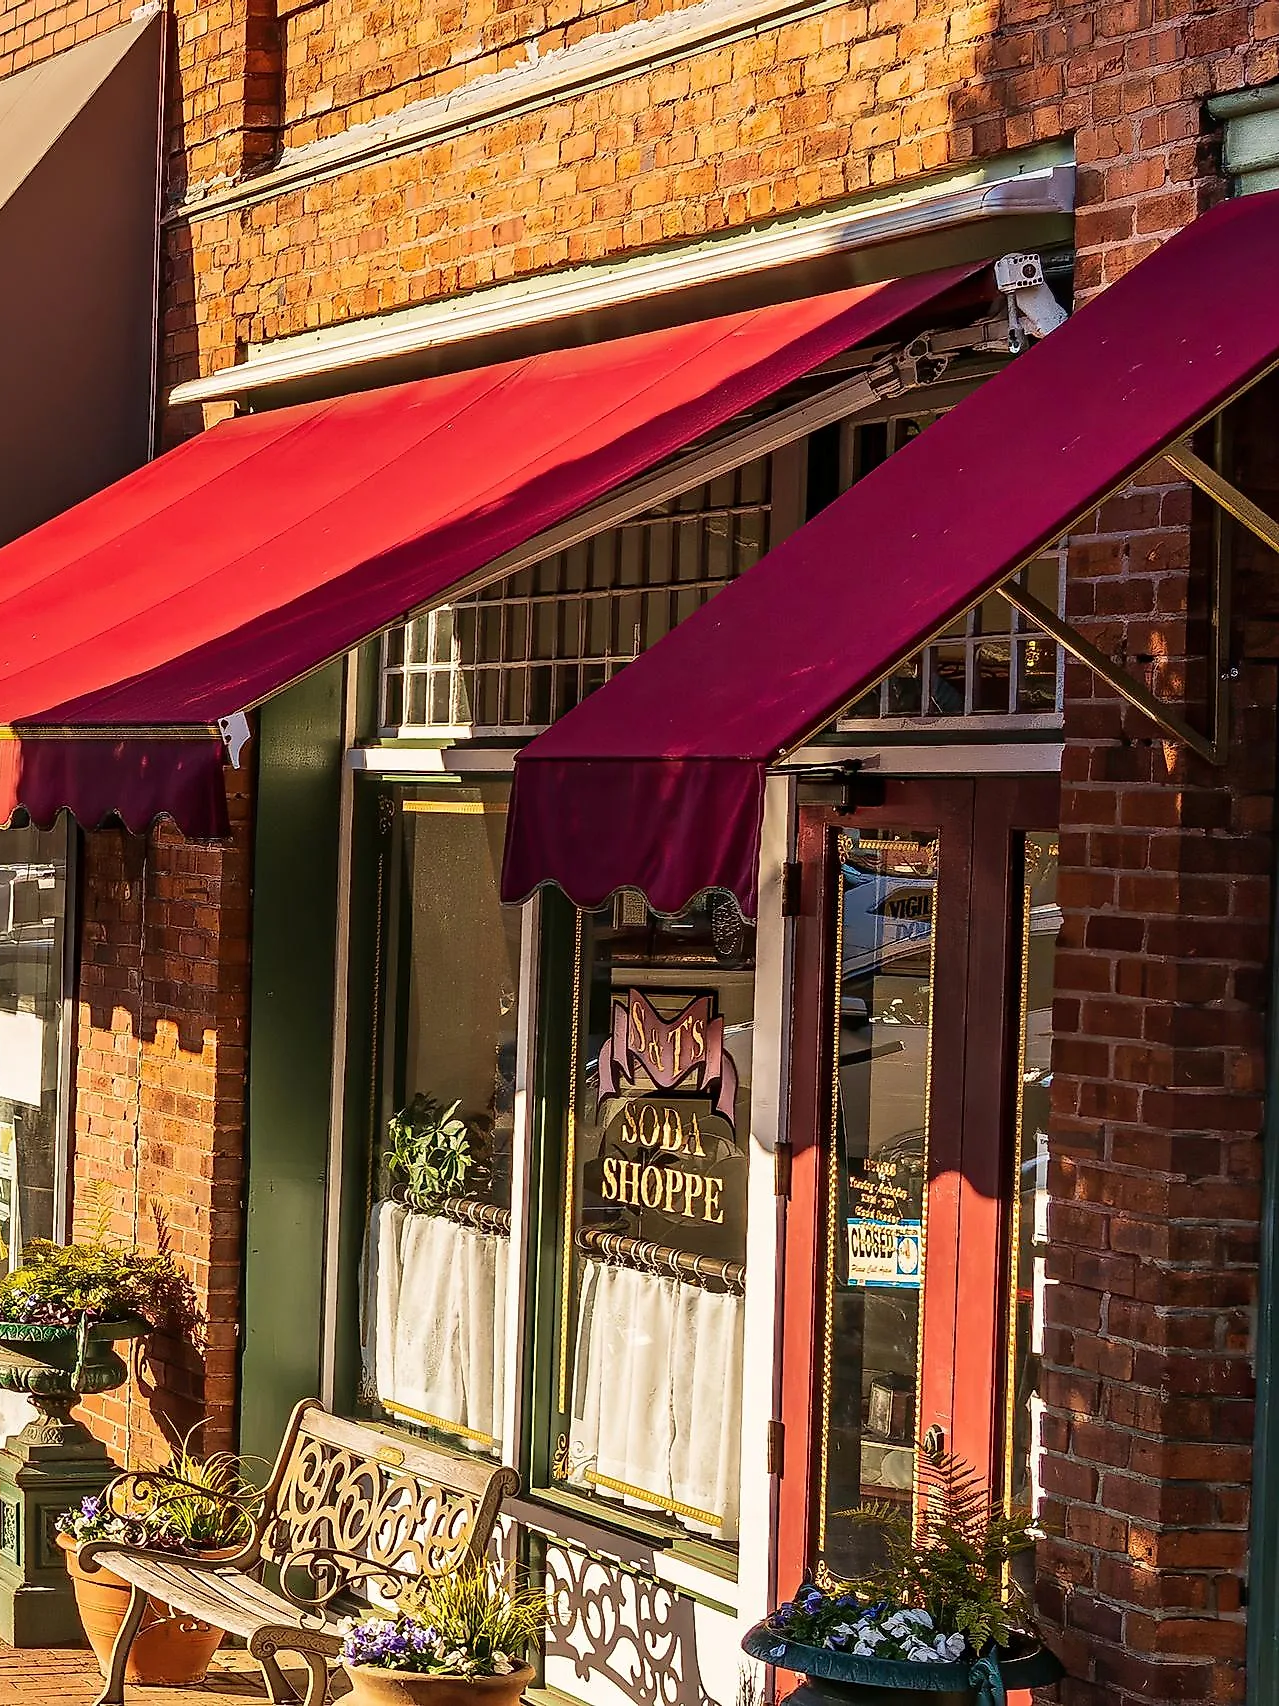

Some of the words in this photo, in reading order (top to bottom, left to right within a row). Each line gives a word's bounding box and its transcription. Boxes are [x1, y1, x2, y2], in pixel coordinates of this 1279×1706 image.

[621, 1102, 707, 1157] SODA
[601, 1157, 724, 1224] SHOPPE
[851, 1227, 894, 1259] CLOSED
